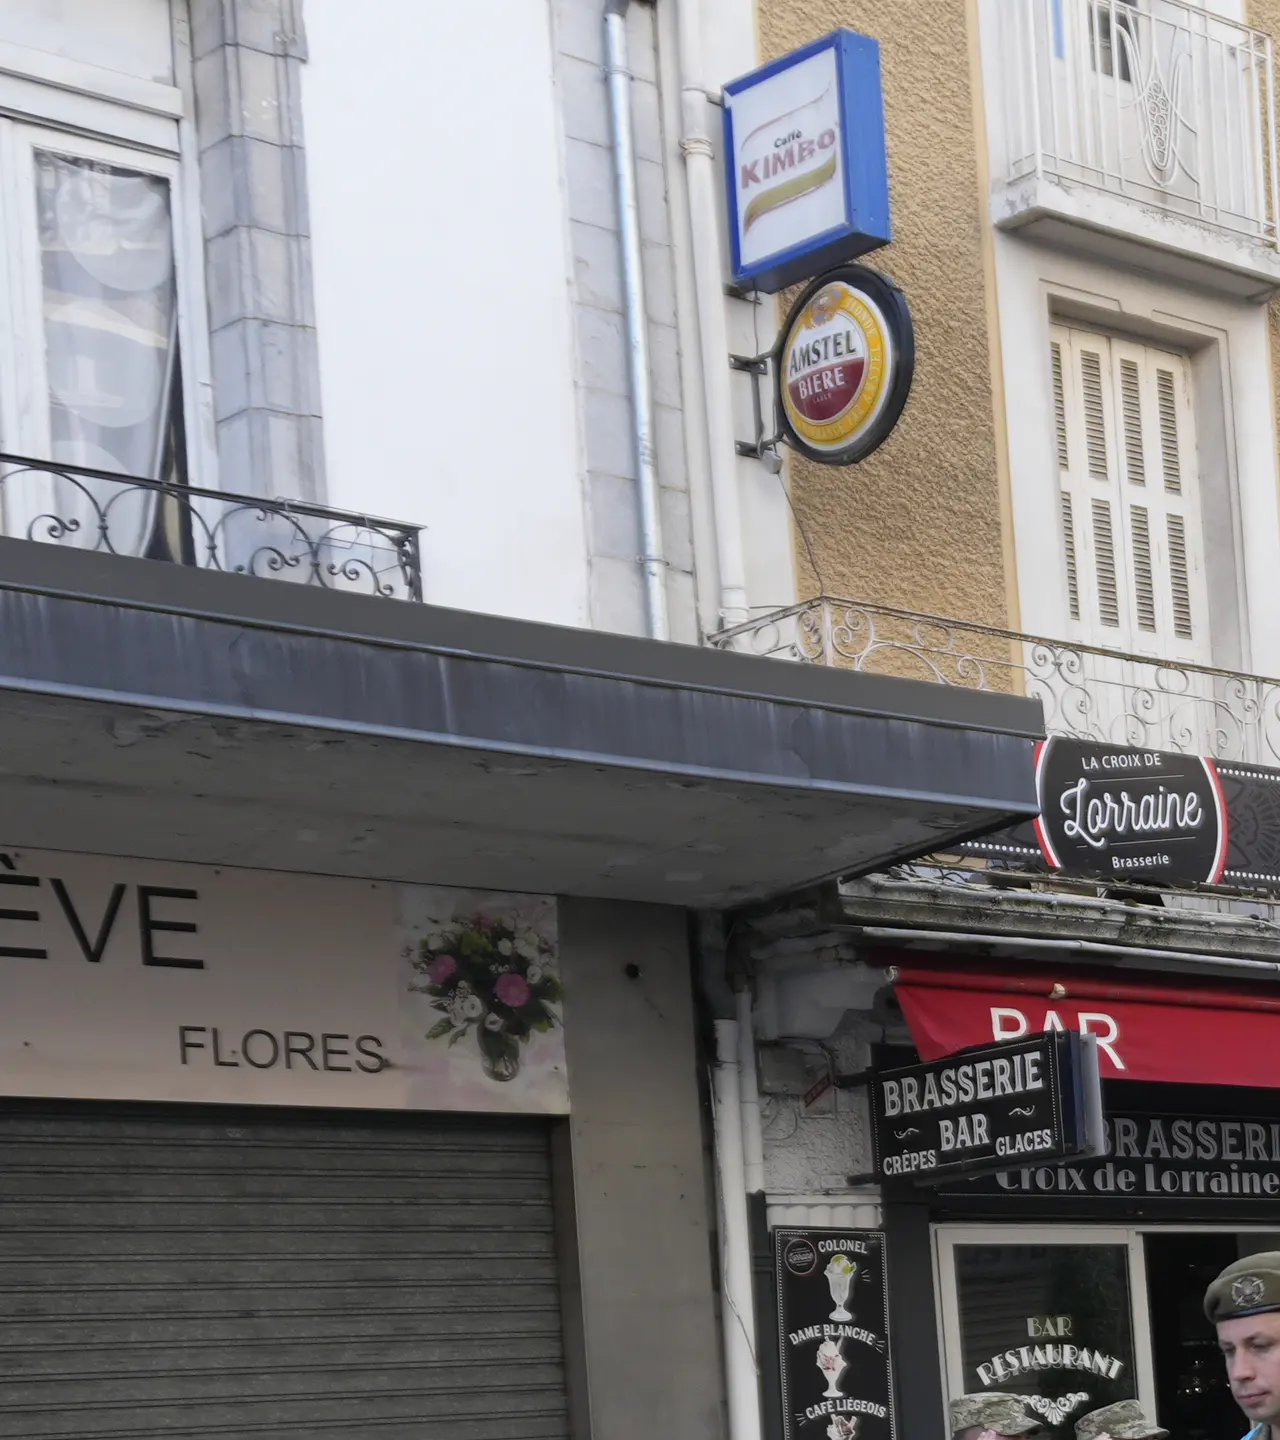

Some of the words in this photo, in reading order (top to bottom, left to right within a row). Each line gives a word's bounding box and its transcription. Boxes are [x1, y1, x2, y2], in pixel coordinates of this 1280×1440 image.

[741, 128, 836, 190] KIMBO
[790, 329, 857, 377] AMSTEL
[798, 366, 846, 400] BIERE
[1081, 756, 1098, 770] LA
[1102, 754, 1141, 769] CROIX
[1144, 753, 1162, 767] DE
[1060, 778, 1202, 847] Lorraine
[1111, 853, 1170, 869] Brasserie
[178, 1025, 386, 1073] FLORES
[883, 1051, 1044, 1118] BRASSERIE
[938, 1114, 990, 1152] BAR
[882, 1149, 937, 1176] CRÊPES
[995, 1128, 1053, 1156] GLACES
[996, 1162, 1088, 1191] Croix
[1094, 1164, 1136, 1193] de
[1145, 1164, 1280, 1195] Lorraine
[817, 1239, 868, 1254] COLONEL
[789, 1326, 821, 1346] DAME
[823, 1324, 876, 1346] BLANCHE
[1027, 1316, 1072, 1337] BAR
[975, 1344, 1125, 1386] RESTAURANT
[805, 1398, 835, 1419] CAFÉ
[837, 1396, 888, 1418] LIÉGEOIS
